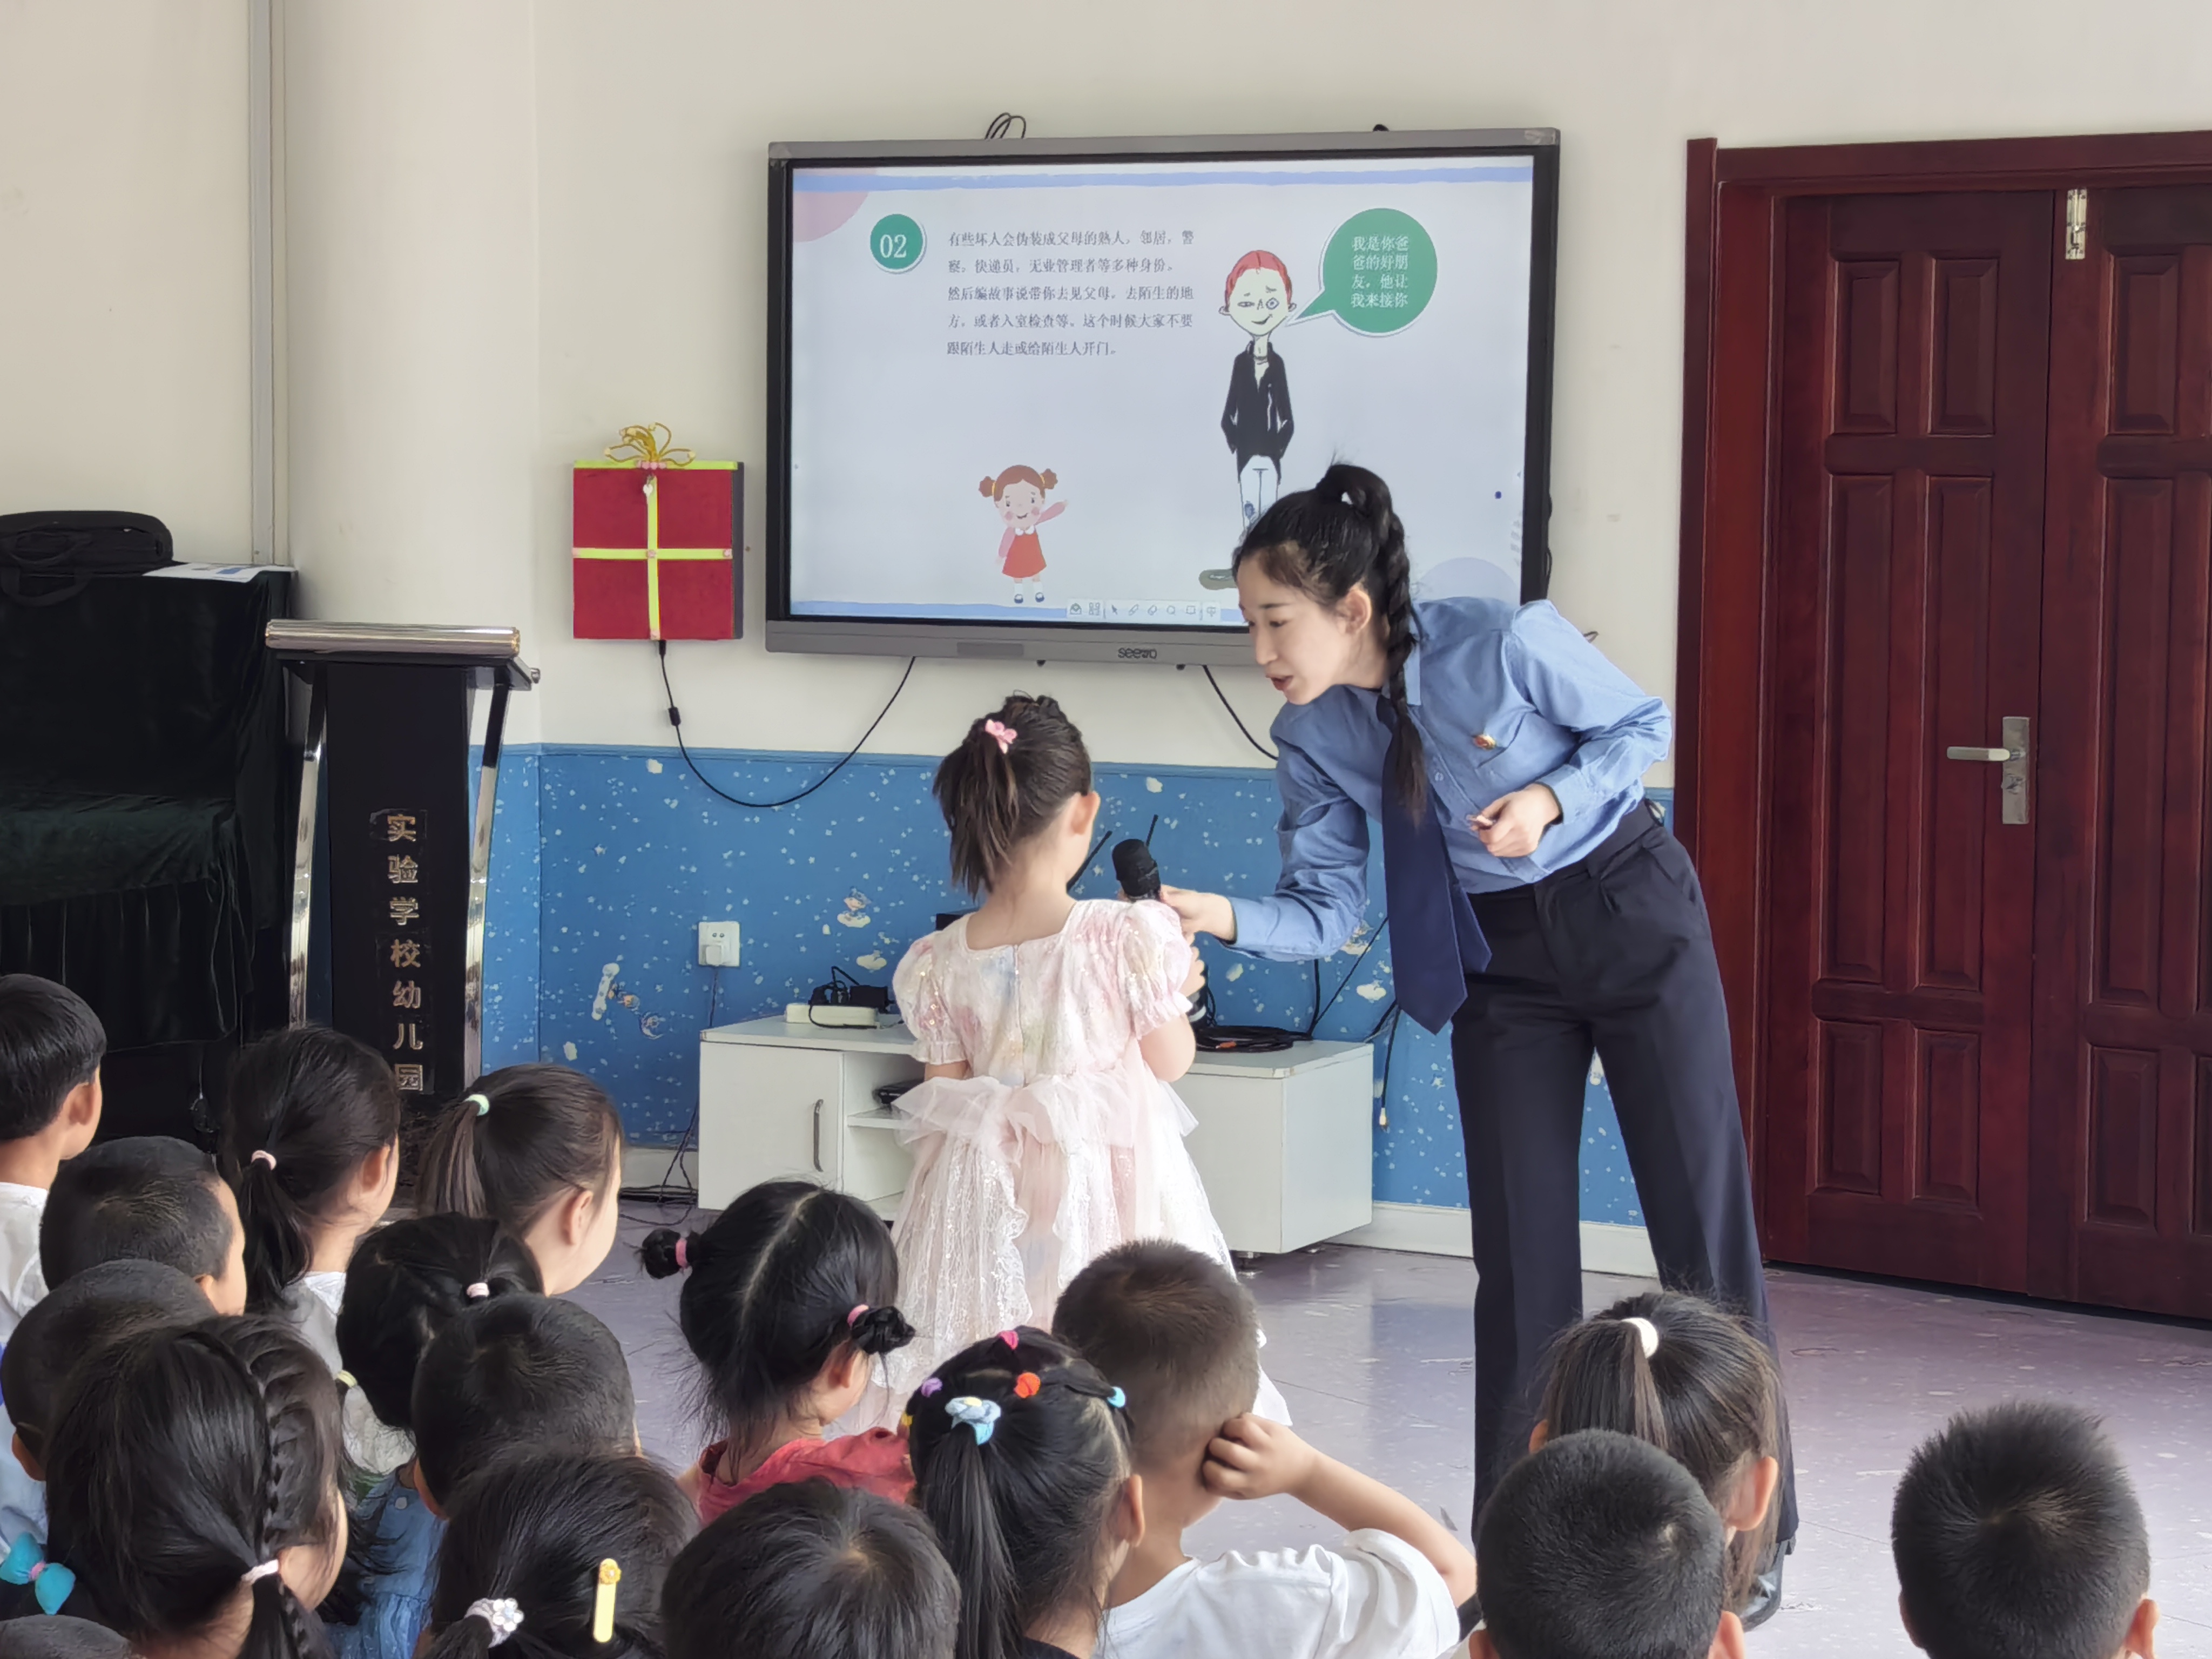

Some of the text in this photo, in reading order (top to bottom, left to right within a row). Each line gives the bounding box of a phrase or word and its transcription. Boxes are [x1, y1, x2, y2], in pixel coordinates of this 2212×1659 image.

[880, 234, 907, 258] 02
[1352, 235, 1408, 251] 我是你爸
[1353, 254, 1408, 271] 爸的好朋
[1351, 292, 1408, 308] 我来接你
[387, 813, 423, 1091] 实验学校幼儿园
